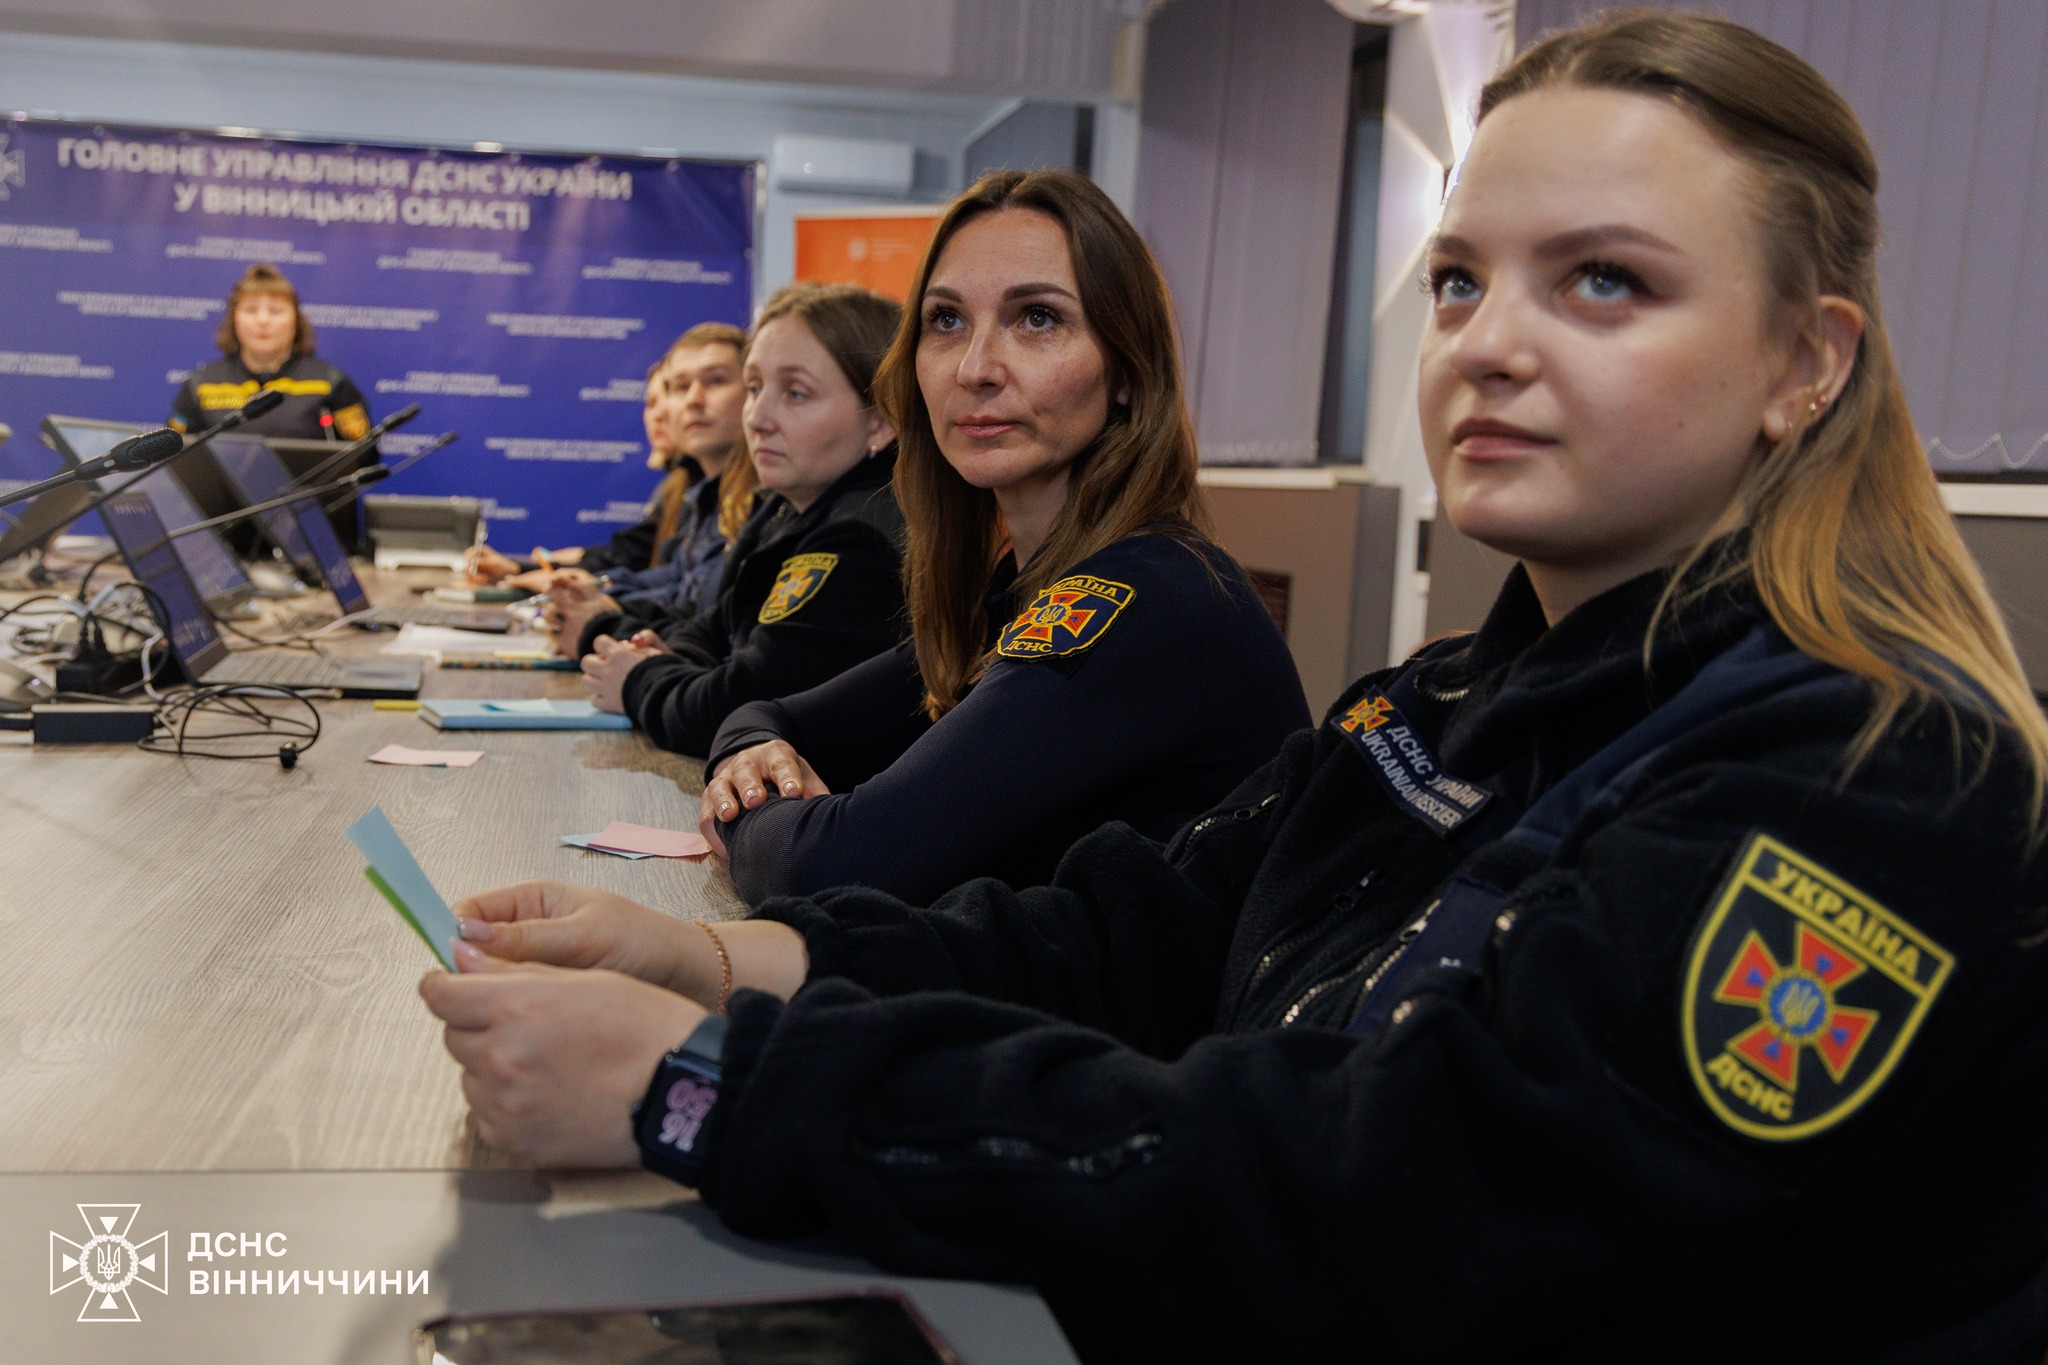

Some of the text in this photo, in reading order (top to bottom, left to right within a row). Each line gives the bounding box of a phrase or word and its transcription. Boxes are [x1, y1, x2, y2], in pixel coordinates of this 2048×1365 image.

[57, 137, 634, 201] ГОЛОВНЕ УПРАВЛІННЯ ДСНС УКРАЇНИ
[173, 182, 531, 231] У ВІННИЦЬКІЙ ОБЛАСТІ
[1003, 640, 1053, 653] ДСНС
[1360, 729, 1421, 803] UKRAINIAN
[1386, 725, 1434, 775] ДСНС
[1705, 1052, 1795, 1121] ДСНС
